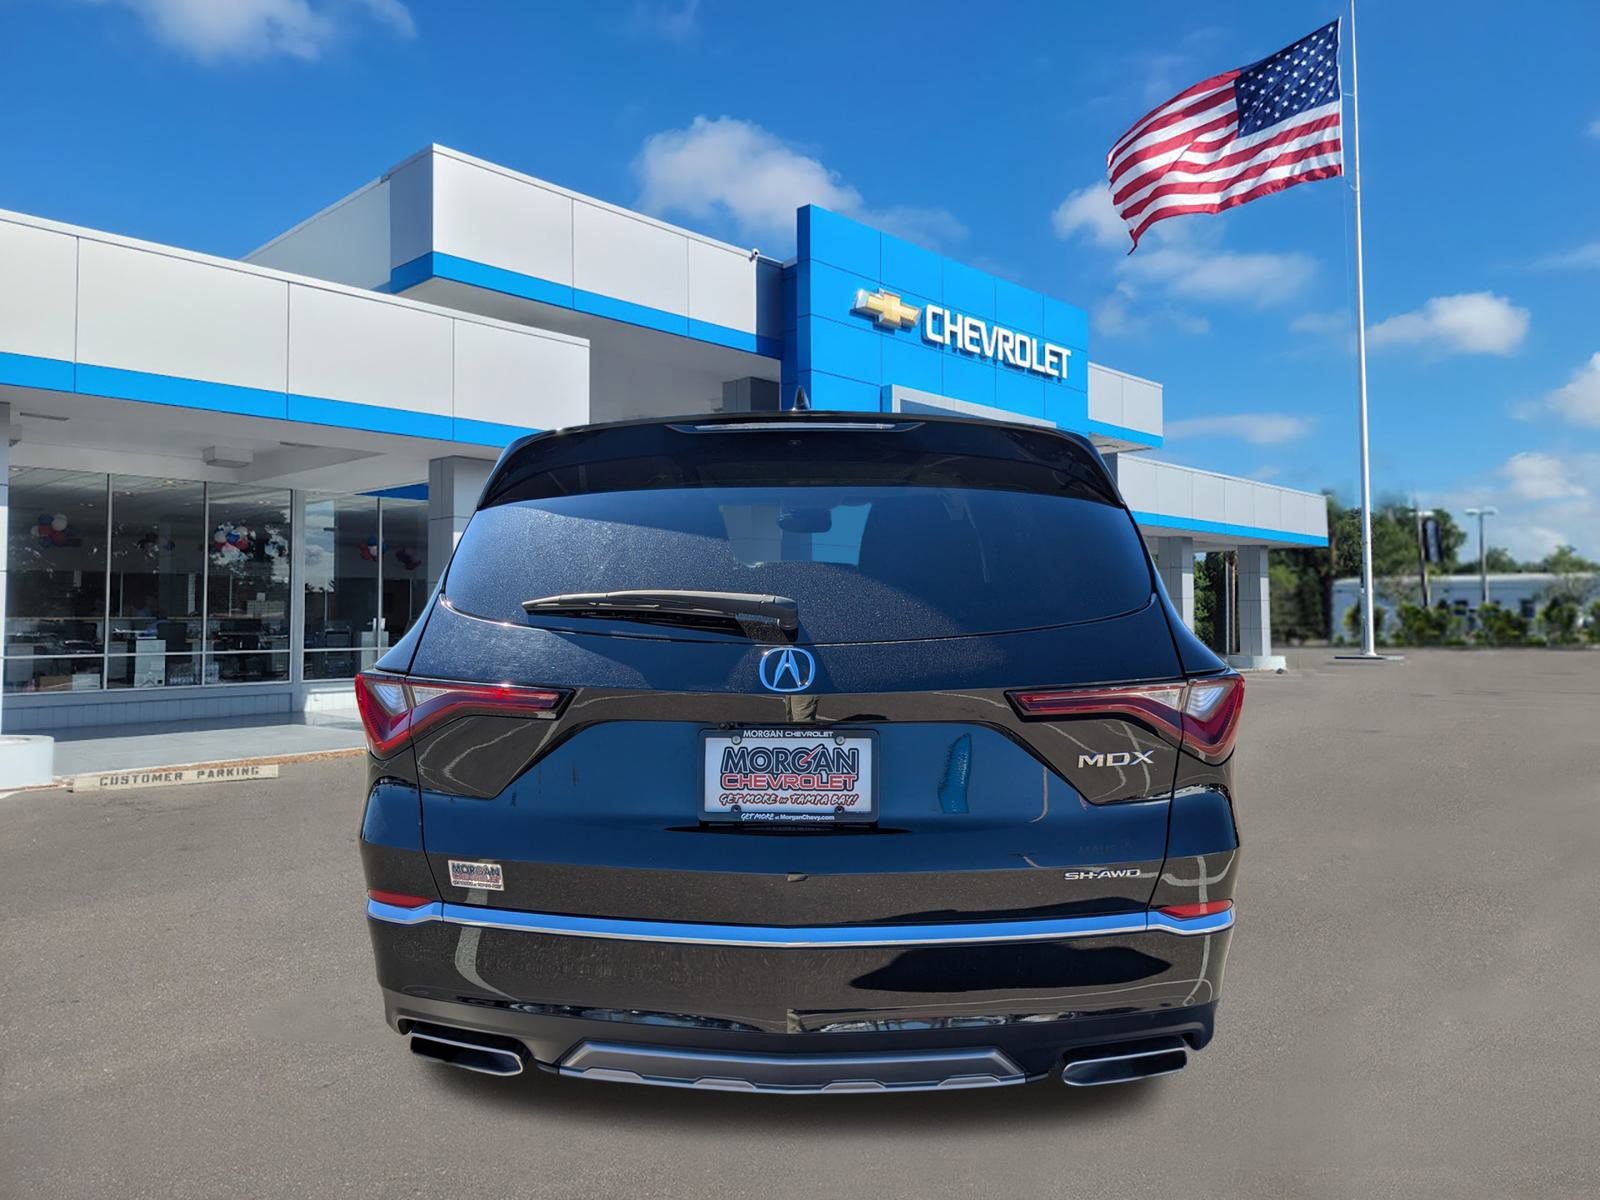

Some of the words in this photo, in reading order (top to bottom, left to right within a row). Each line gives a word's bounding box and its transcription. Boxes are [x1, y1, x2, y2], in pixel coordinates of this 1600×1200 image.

[926, 304, 1072, 379] CHEVROLET
[721, 745, 859, 775] MORGAN
[1078, 750, 1154, 769] MDX
[99, 771, 183, 787] CUSTOMER
[196, 765, 259, 780] PARKING
[721, 773, 858, 790] CHEVROLET
[719, 793, 743, 806] GET
[742, 794, 777, 805] MORE
[789, 793, 829, 805] TAMPA
[452, 863, 500, 877] MORGAN
[1064, 868, 1141, 881] SH-AWD
